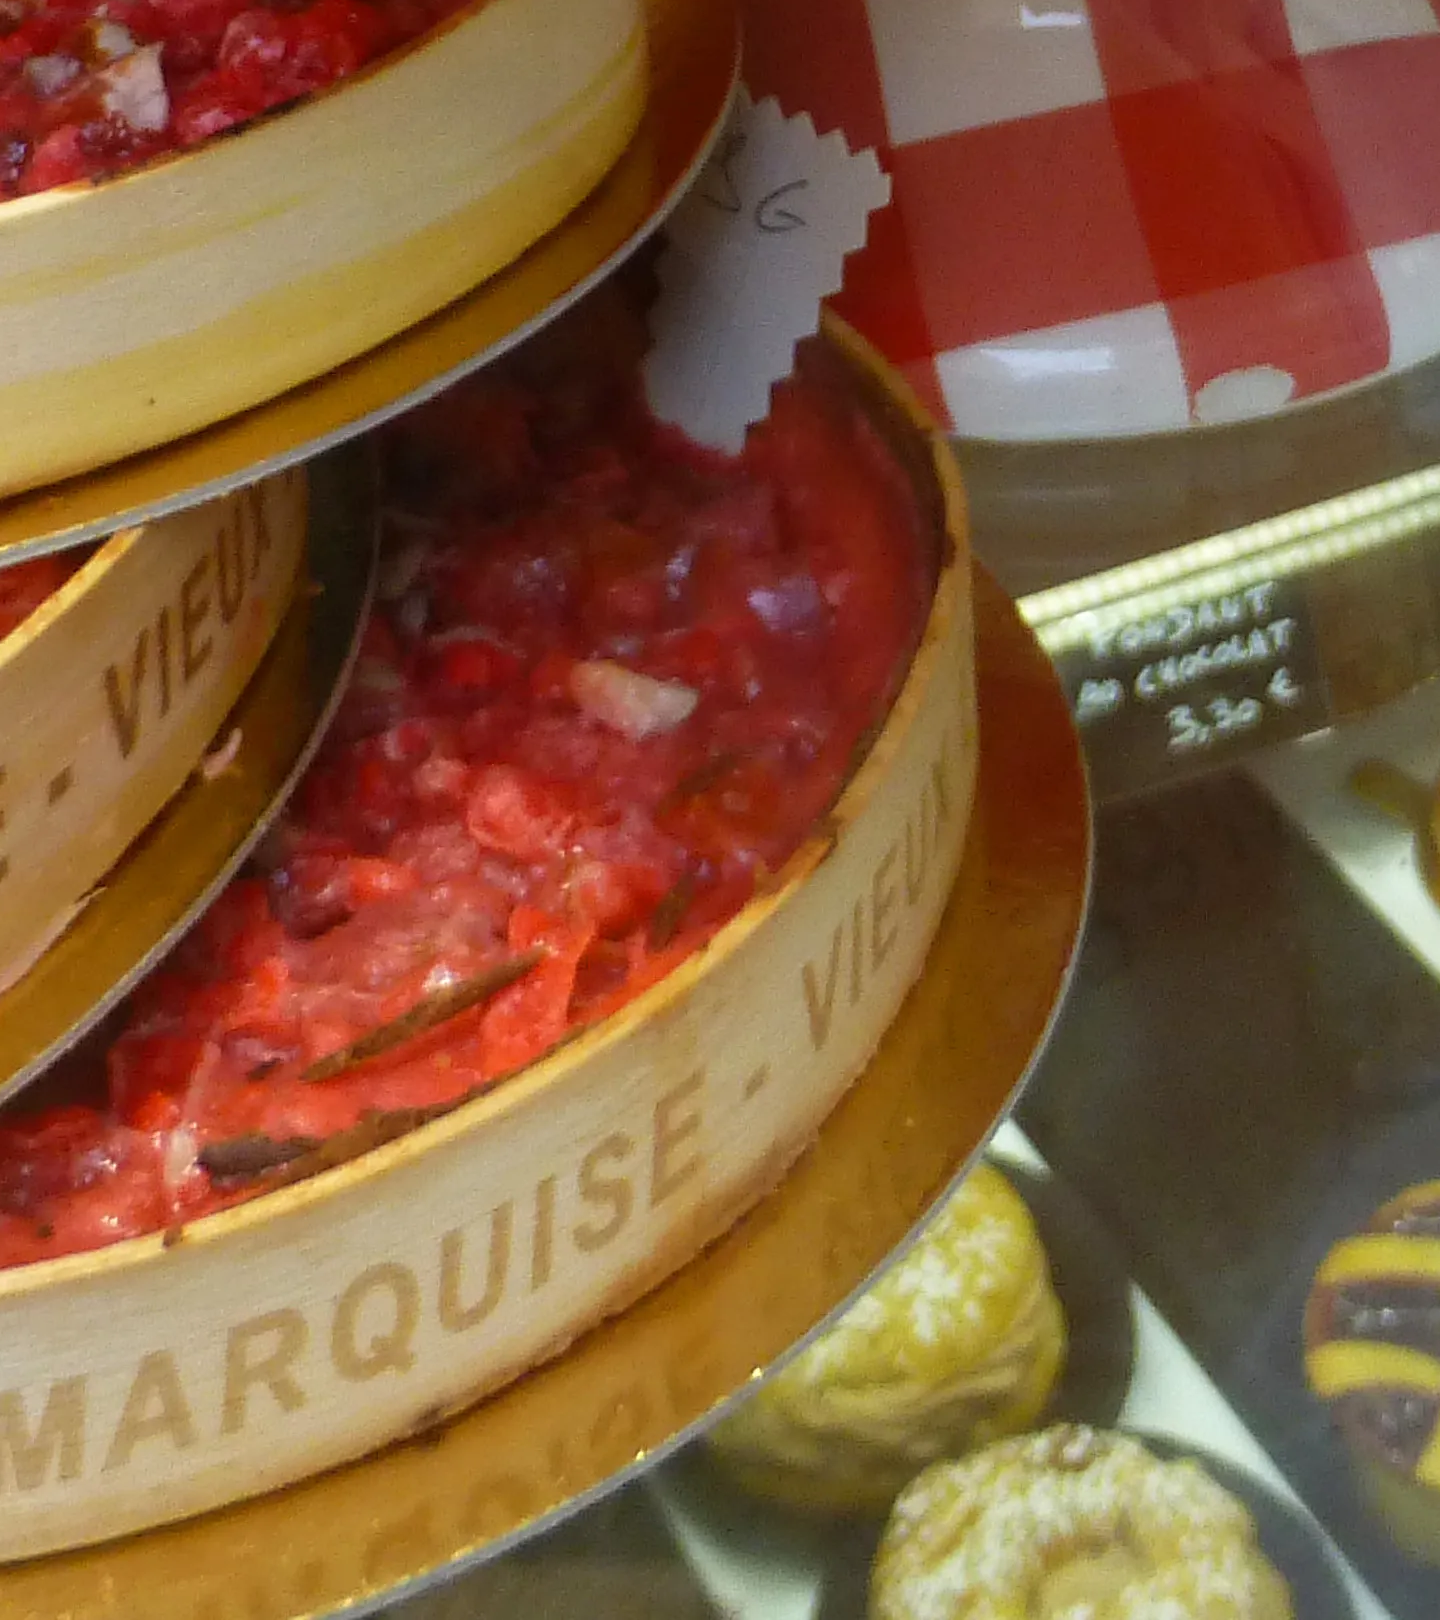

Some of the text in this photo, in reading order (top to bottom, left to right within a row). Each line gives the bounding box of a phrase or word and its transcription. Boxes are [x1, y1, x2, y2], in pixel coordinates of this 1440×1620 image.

[101, 478, 274, 762] VIEUX
[1134, 617, 1297, 700] CHOCOLAT
[801, 732, 950, 1053] VIEUX
